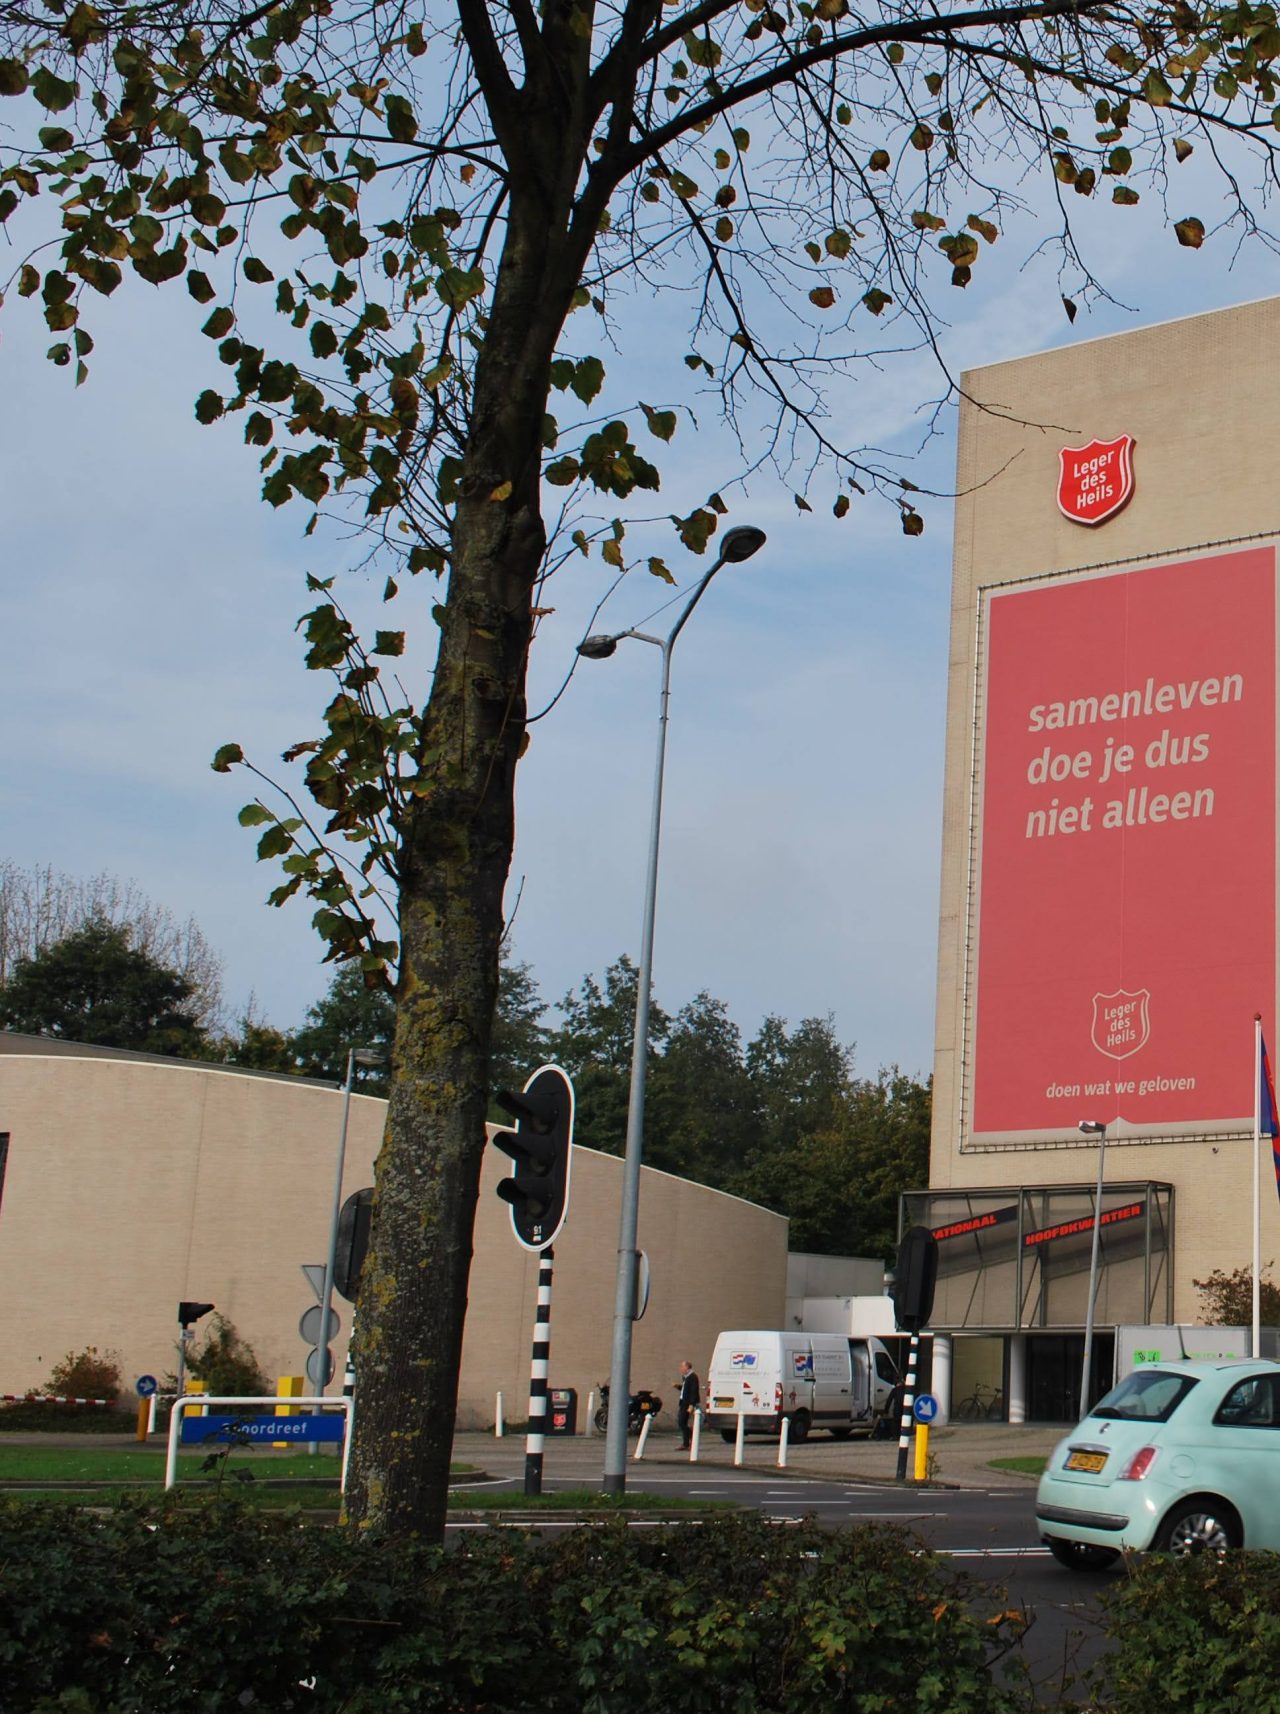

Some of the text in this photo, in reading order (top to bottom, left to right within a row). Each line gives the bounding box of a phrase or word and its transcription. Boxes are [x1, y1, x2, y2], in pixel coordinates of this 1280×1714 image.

[1073, 450, 1115, 478] Leger
[1080, 471, 1107, 491] des
[1076, 484, 1114, 510] Heils
[1027, 672, 1244, 732] samenleven
[1026, 729, 1210, 785] doe je dus
[1025, 786, 1215, 838] niet alleen
[1104, 1001, 1137, 1020] Leger
[1110, 1017, 1131, 1032] des
[1107, 1028, 1136, 1047] Heils
[1046, 1075, 1196, 1099] doen wat we geloven
[932, 1214, 997, 1240] ATIONAAL
[221, 1422, 308, 1436] Soordreef
